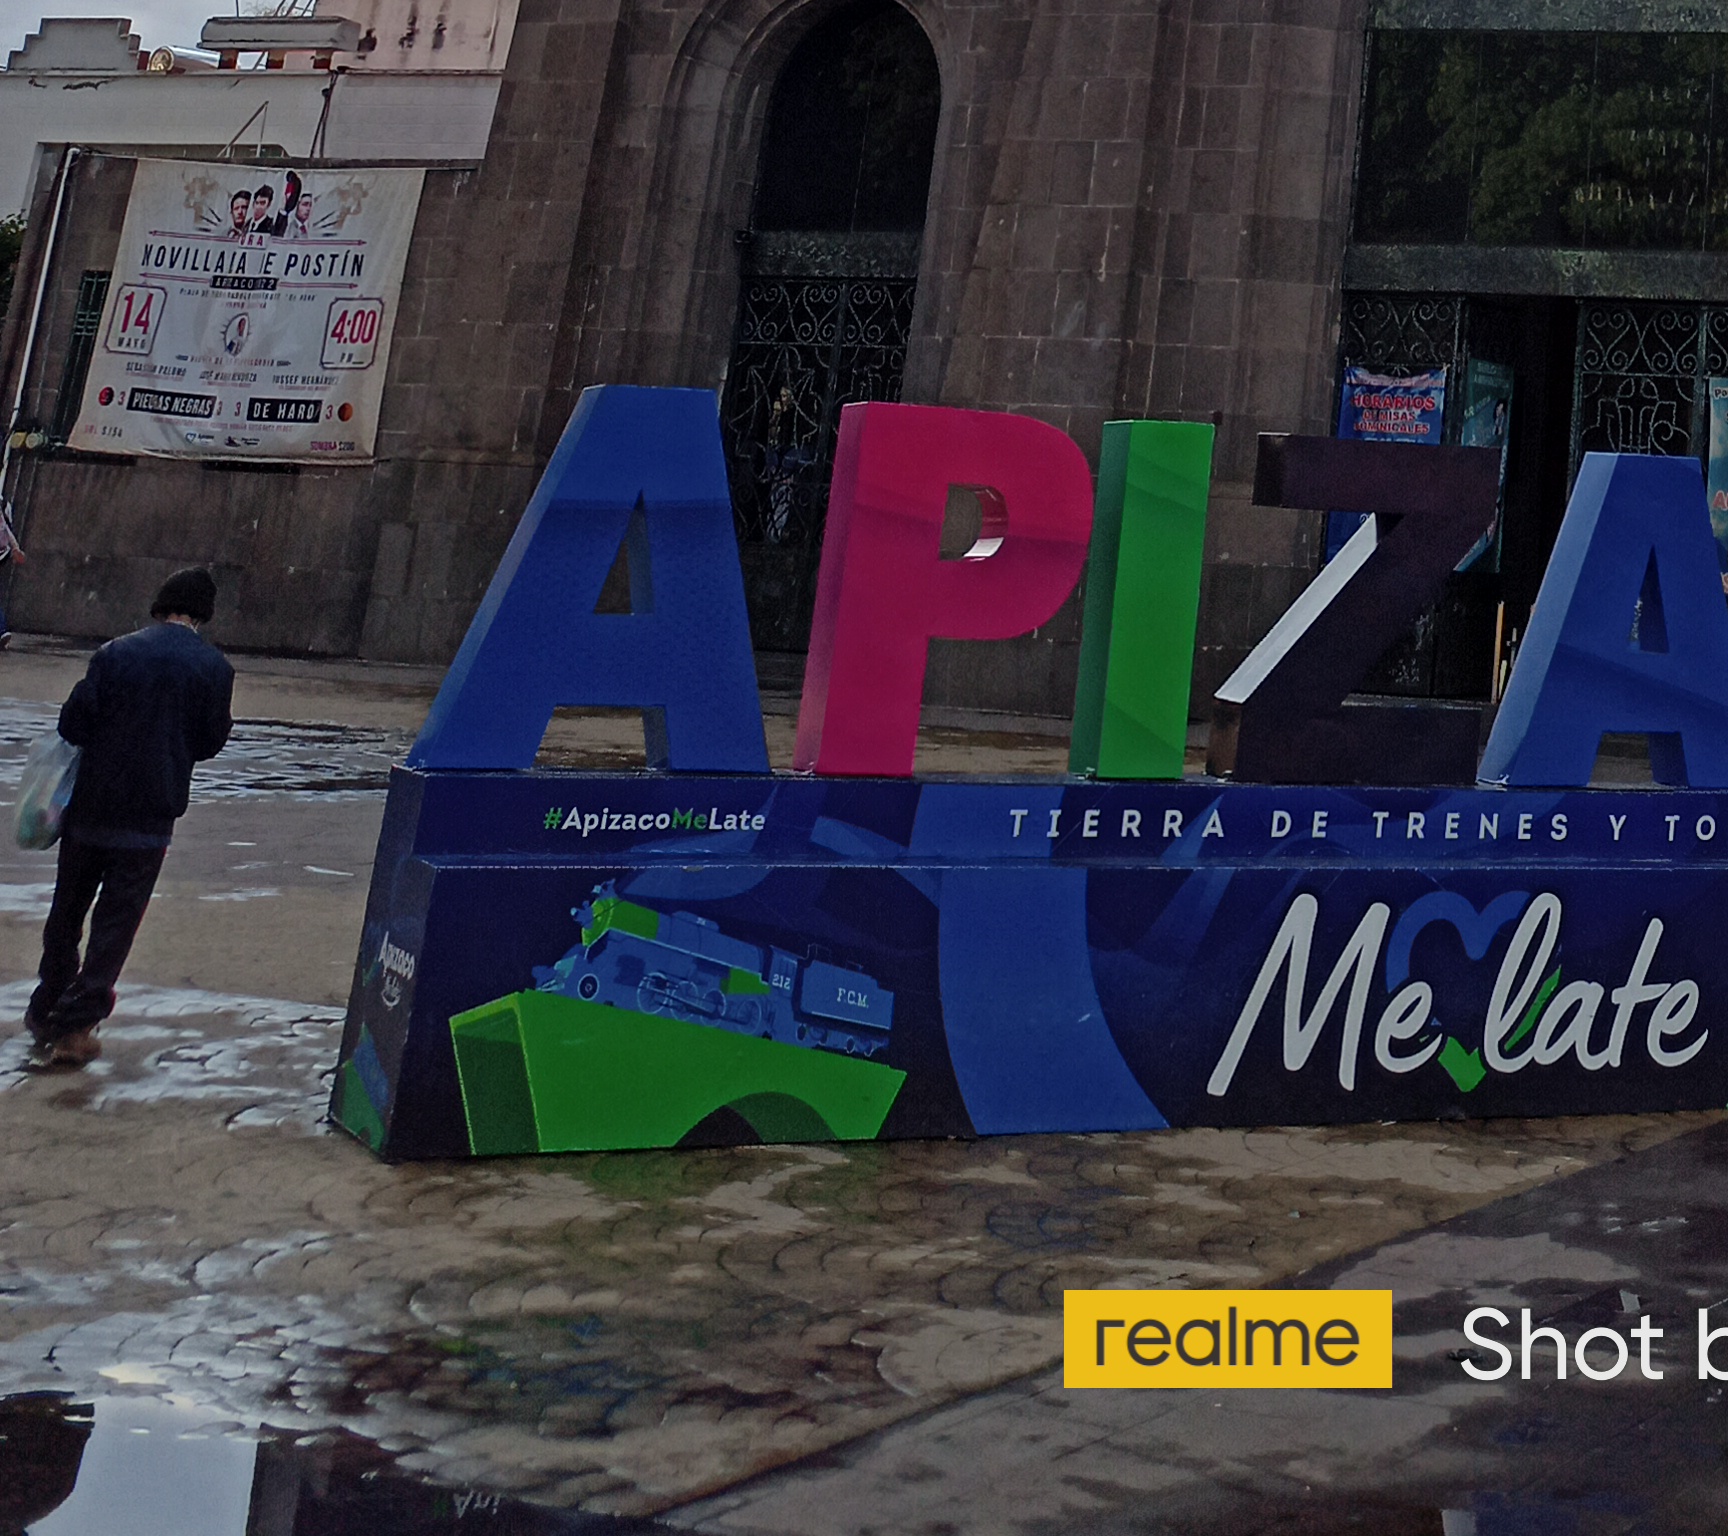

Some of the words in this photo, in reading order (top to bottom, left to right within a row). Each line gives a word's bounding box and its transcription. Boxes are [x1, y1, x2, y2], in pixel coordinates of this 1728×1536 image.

[284, 249, 365, 277] POSTÍN
[119, 290, 153, 335] 14
[330, 309, 377, 345] 4:00
[117, 336, 146, 349] MAYO
[118, 391, 126, 405] 3
[170, 396, 212, 416] NEGRAS
[252, 401, 271, 418] DE
[277, 402, 316, 420] HARO
[325, 404, 333, 420] 3
[1350, 393, 1436, 412] HORARIOS
[1379, 410, 1417, 423] MISAS
[543, 804, 767, 837] #ApizacoMeLate
[1009, 808, 1226, 840] TIERRA
[1269, 810, 1332, 841] DE
[1373, 811, 1570, 842] TRENES
[1608, 813, 1628, 842] Y
[772, 973, 791, 991] 212
[1206, 891, 1441, 1096] Me
[1482, 891, 1709, 1074] late
